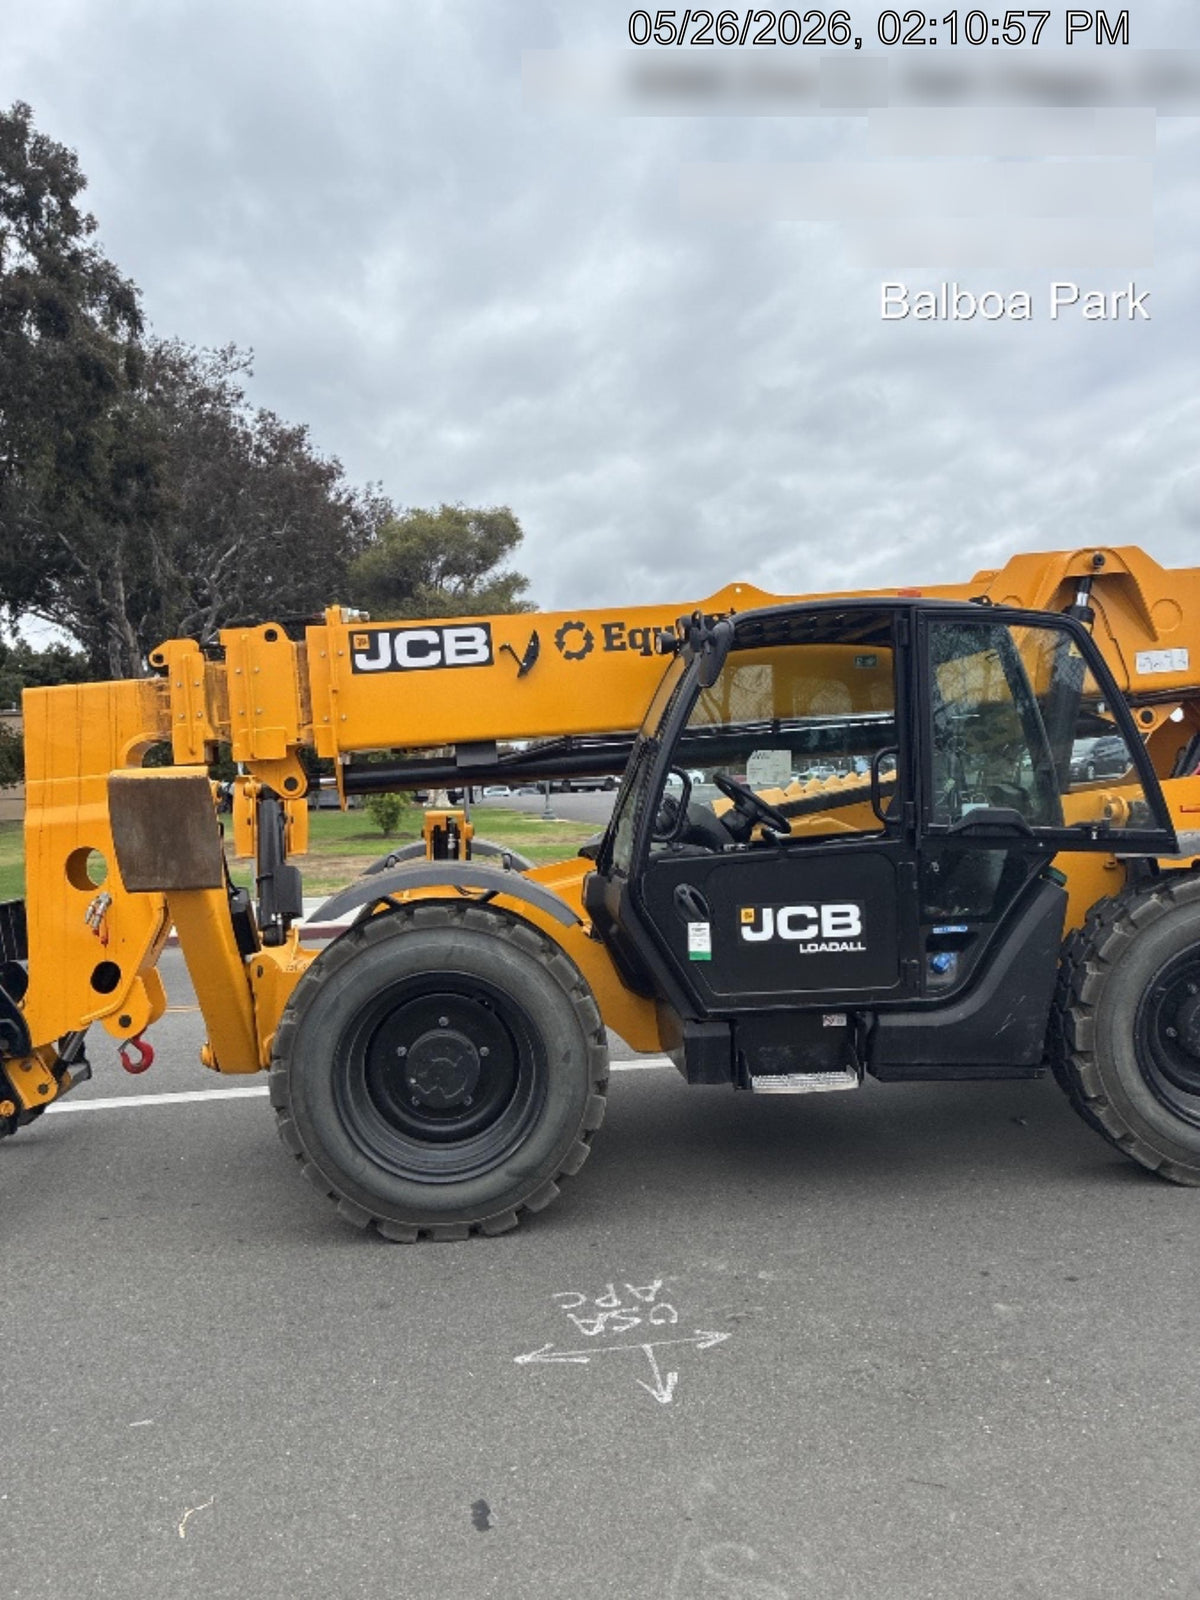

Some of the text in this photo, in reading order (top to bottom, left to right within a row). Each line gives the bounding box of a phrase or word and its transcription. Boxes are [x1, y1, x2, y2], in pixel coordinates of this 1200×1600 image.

[354, 627, 490, 670] JCB
[741, 904, 862, 941] JCB
[799, 942, 866, 953] LOADALL
